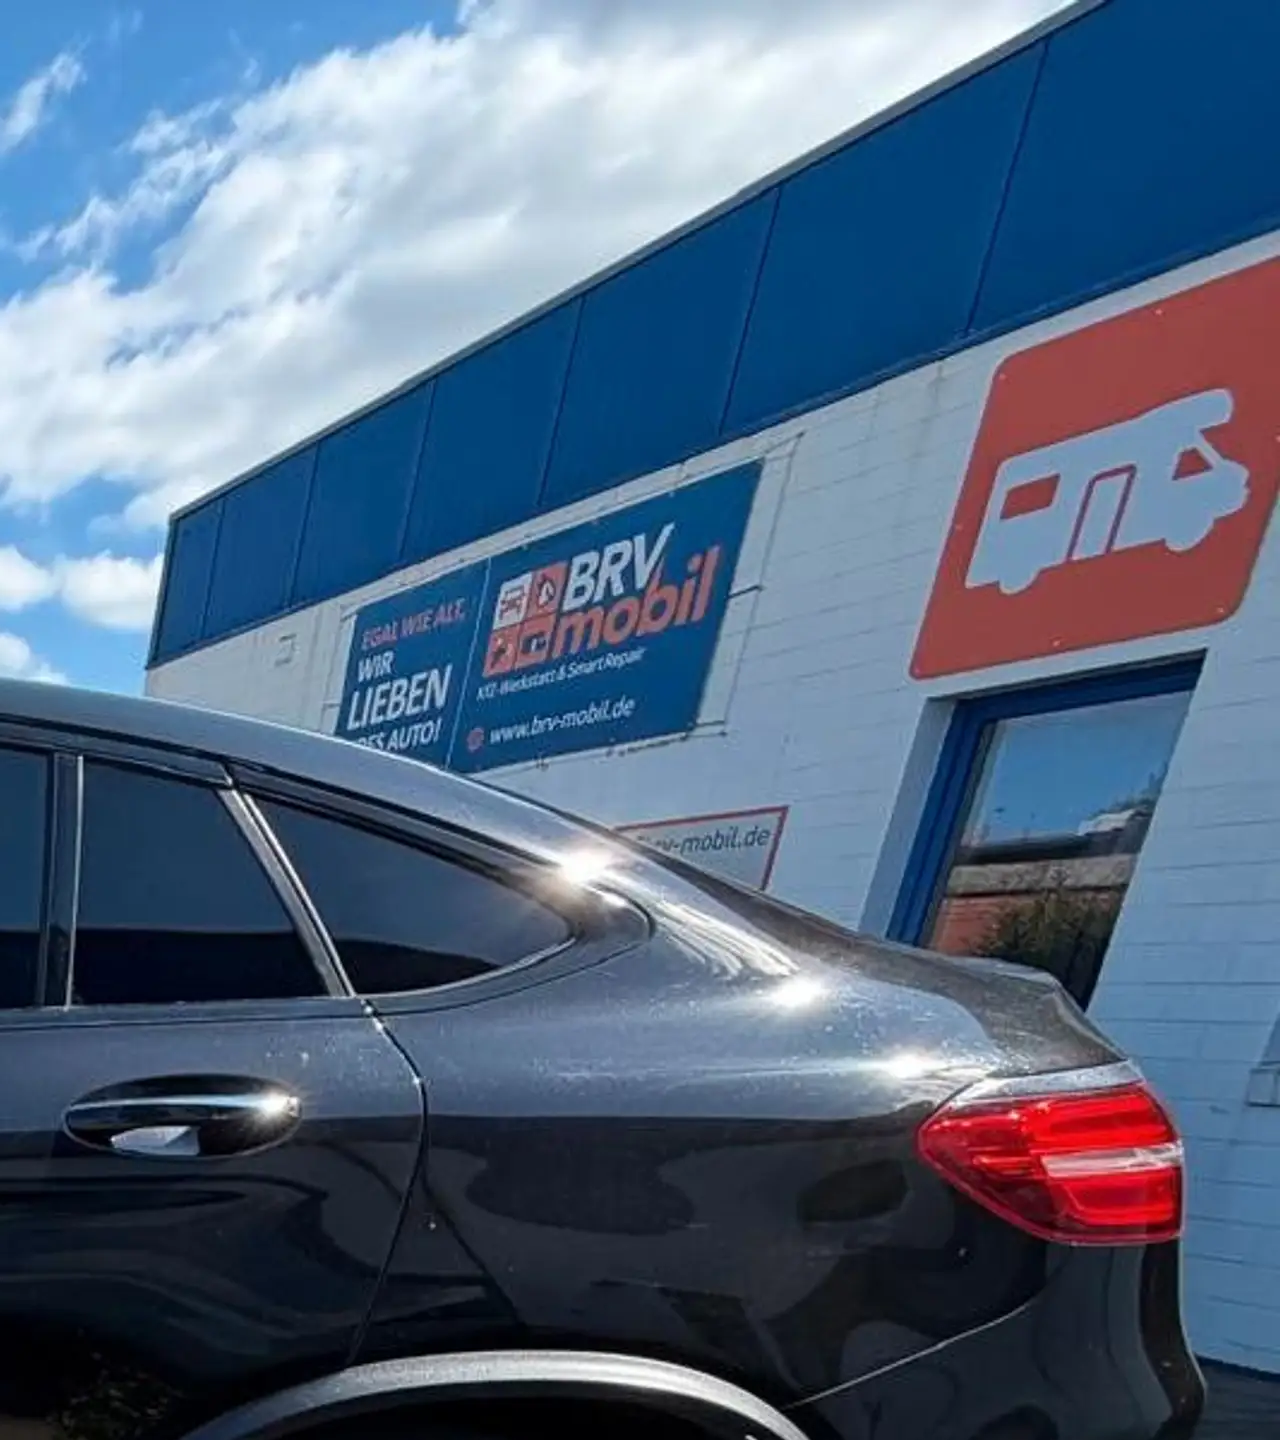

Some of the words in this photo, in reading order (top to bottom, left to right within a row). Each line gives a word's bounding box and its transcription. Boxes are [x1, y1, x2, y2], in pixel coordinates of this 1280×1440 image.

[562, 522, 676, 612] BRV
[551, 545, 721, 658] mobil
[360, 621, 398, 651] EGAL
[400, 609, 434, 637] WIE
[358, 651, 394, 682] WIR
[567, 656, 605, 679] Smart
[604, 647, 647, 670] Repair
[347, 663, 453, 731] LIEBEN
[490, 695, 636, 744] www.brv-mobil.de
[387, 717, 443, 750] AUTO!
